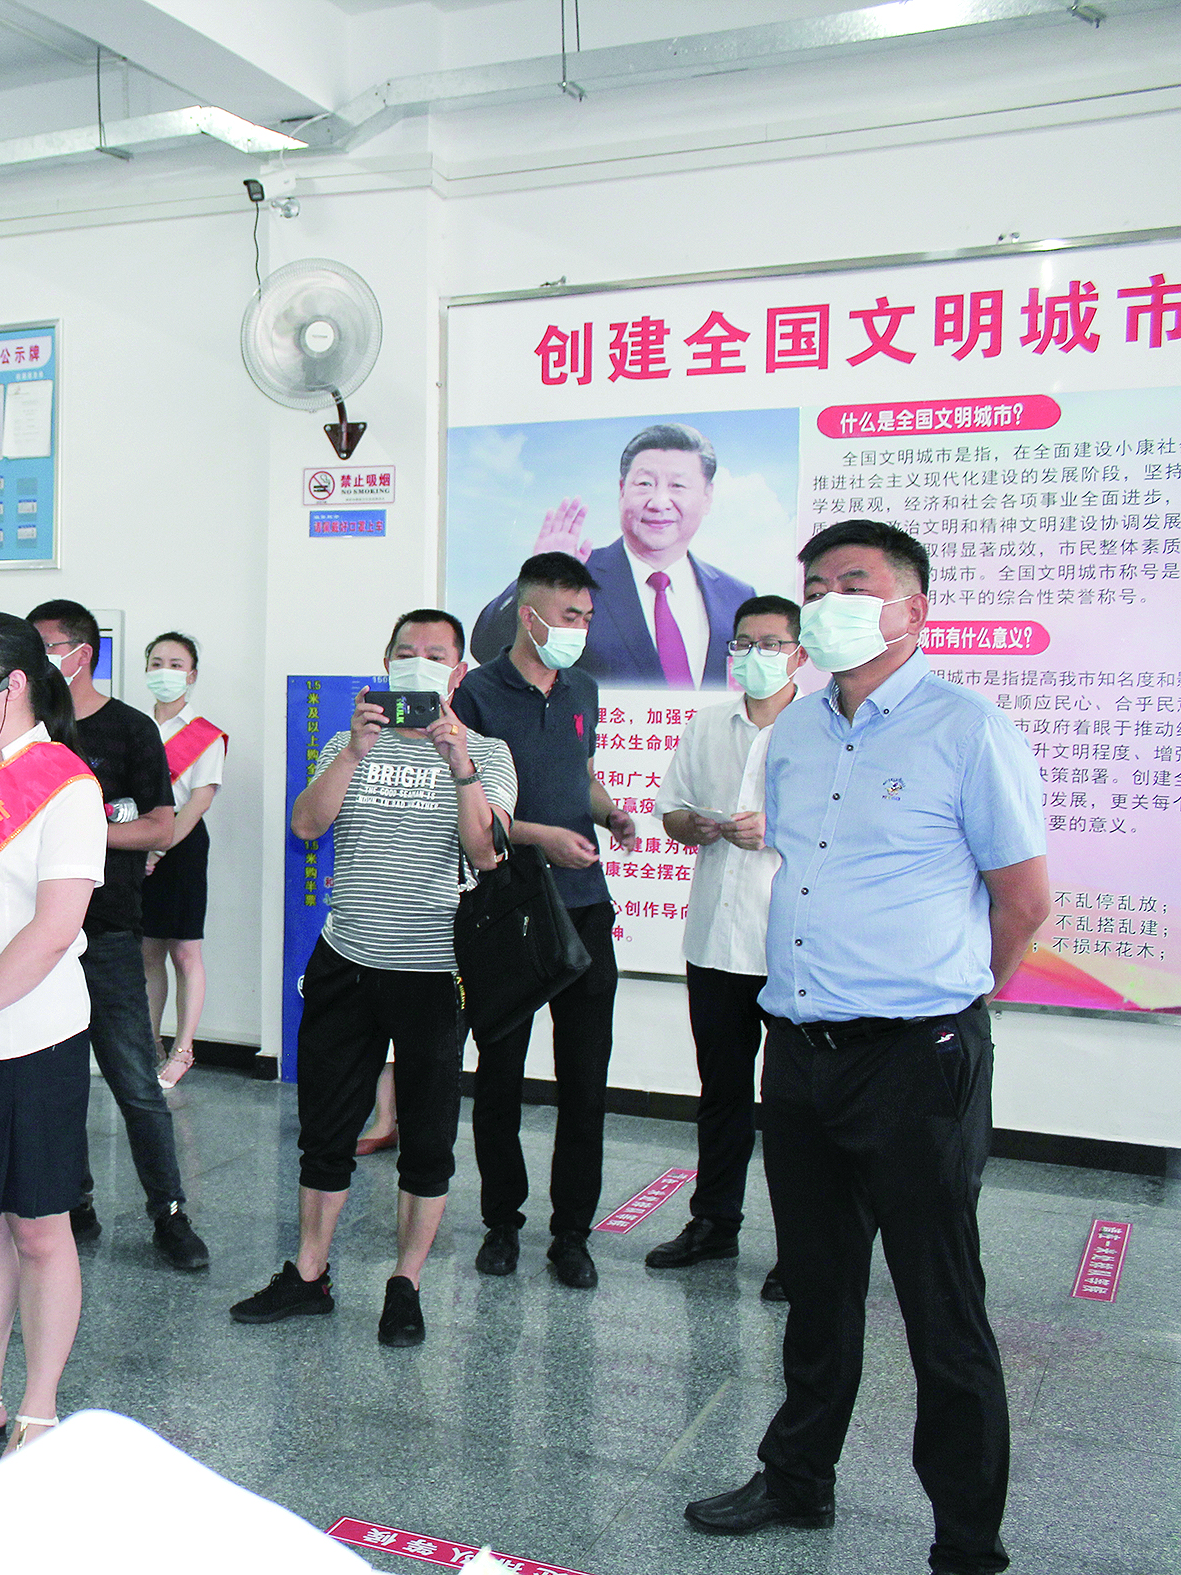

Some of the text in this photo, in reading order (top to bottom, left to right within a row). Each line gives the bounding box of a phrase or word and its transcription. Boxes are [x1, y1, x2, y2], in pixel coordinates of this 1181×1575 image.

[534, 274, 1181, 386] 创建全国文明城市
[842, 437, 1181, 467] 全国文明城市是指，在全面建设小康社
[341, 473, 391, 488] 禁止吸烟
[306, 680, 322, 786] 1.5米及以上购全
[366, 763, 441, 789] BRIGHT
[1042, 791, 1181, 812] 发展，更关每
[1046, 815, 1137, 834] 要的意义。
[602, 861, 695, 881] 康安全摆在
